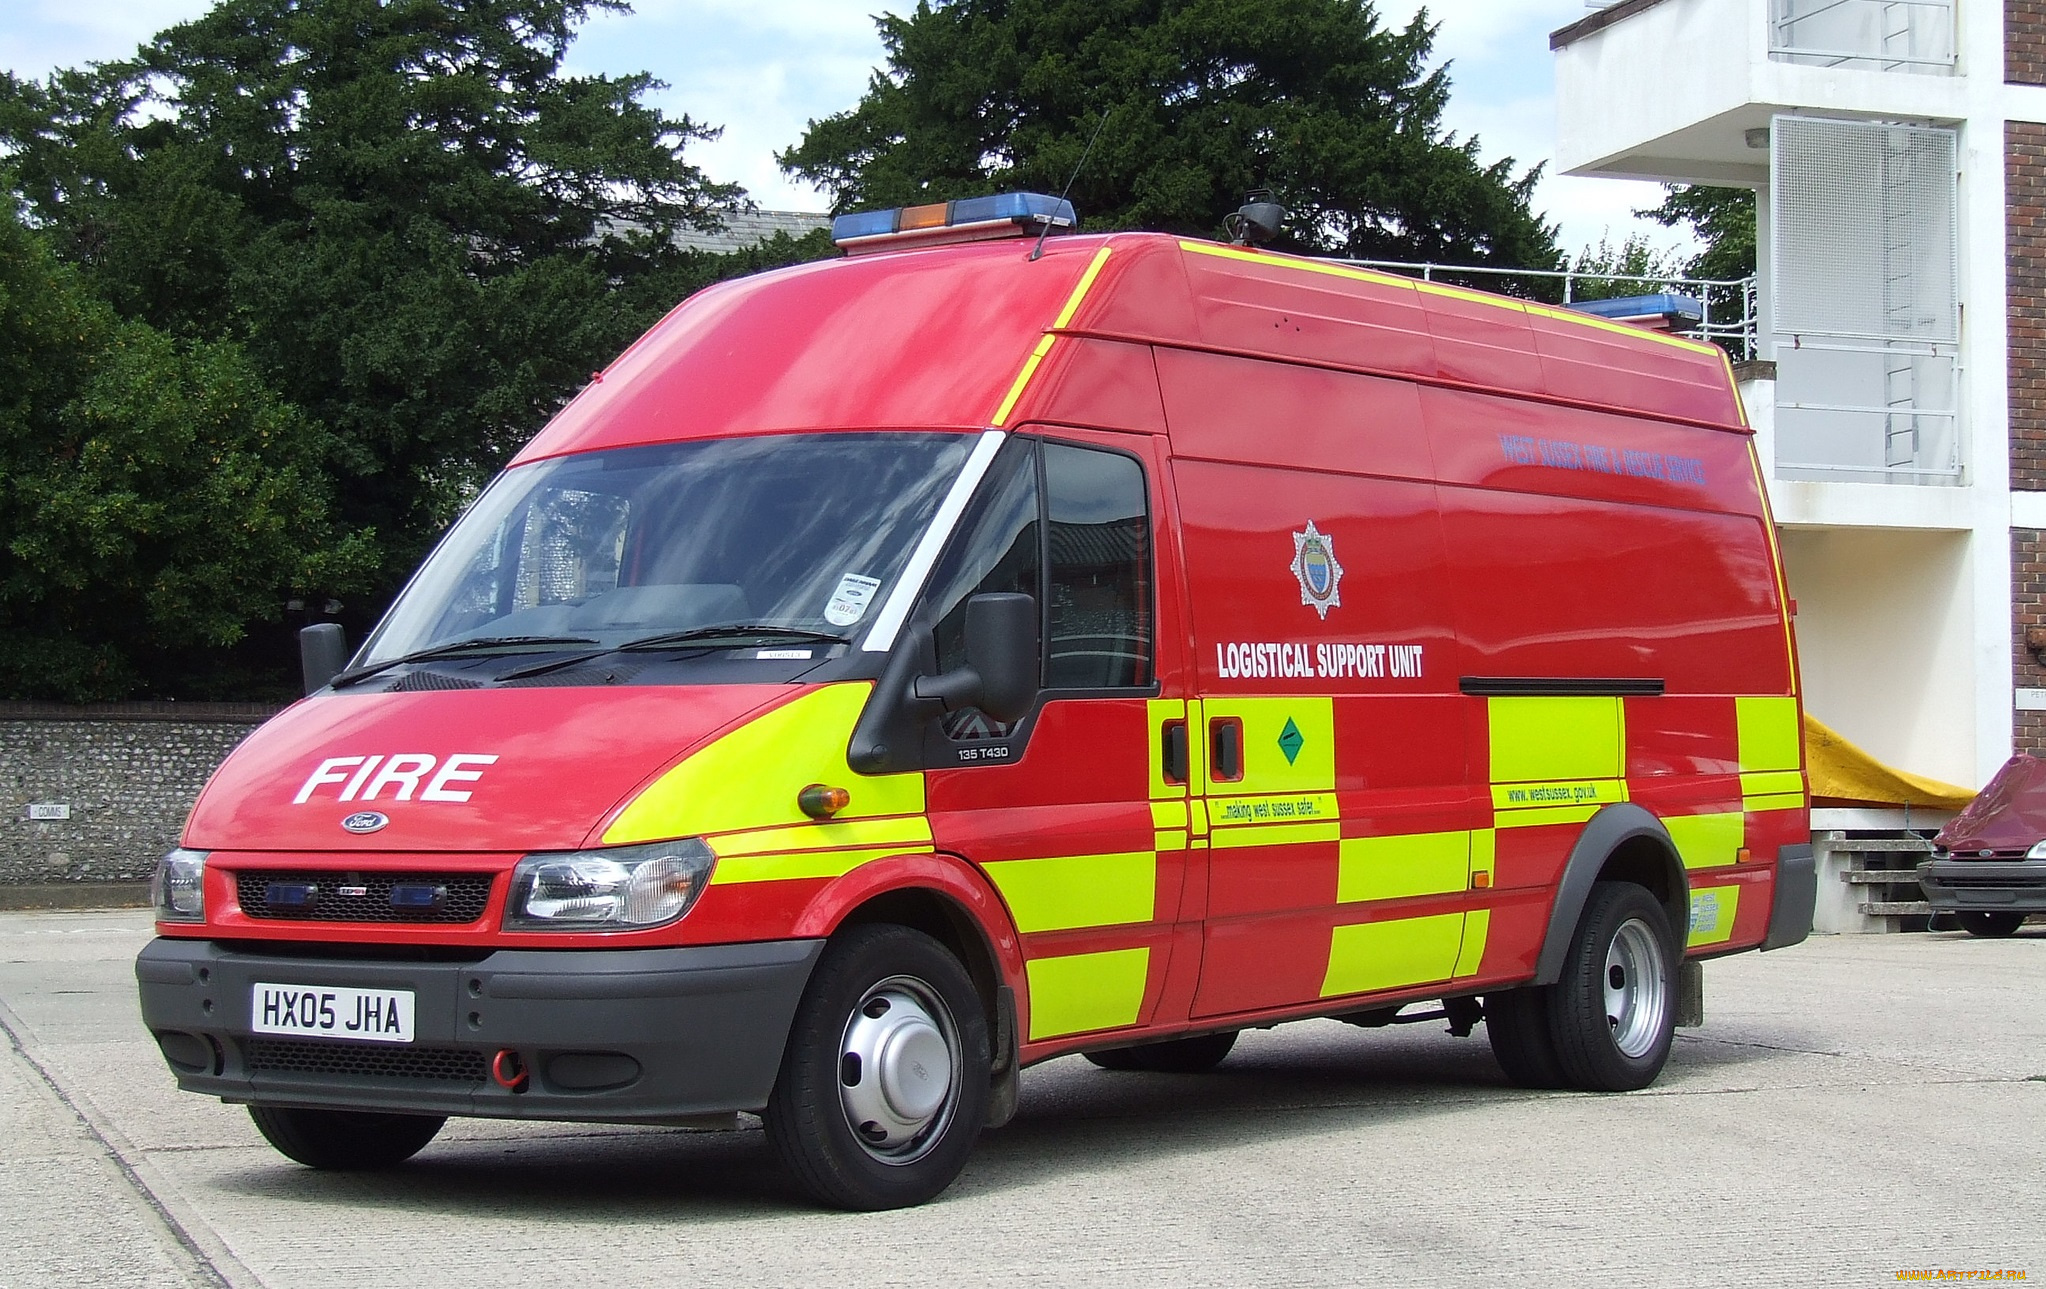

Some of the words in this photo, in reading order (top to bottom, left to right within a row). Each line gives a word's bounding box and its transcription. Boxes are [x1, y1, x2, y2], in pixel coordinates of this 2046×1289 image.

[1583, 444, 1610, 473] FIRE
[1217, 643, 1314, 677] LOGISTICAL
[1317, 643, 1385, 677] SUPPORT
[1388, 645, 1423, 677] UNIT
[958, 749, 978, 760] 135
[980, 747, 1009, 758] T430
[292, 753, 500, 804] FIRE
[1253, 800, 1270, 817] west
[1271, 802, 1296, 817] sussex
[264, 990, 336, 1030] HX05
[345, 995, 401, 1033] JHA
